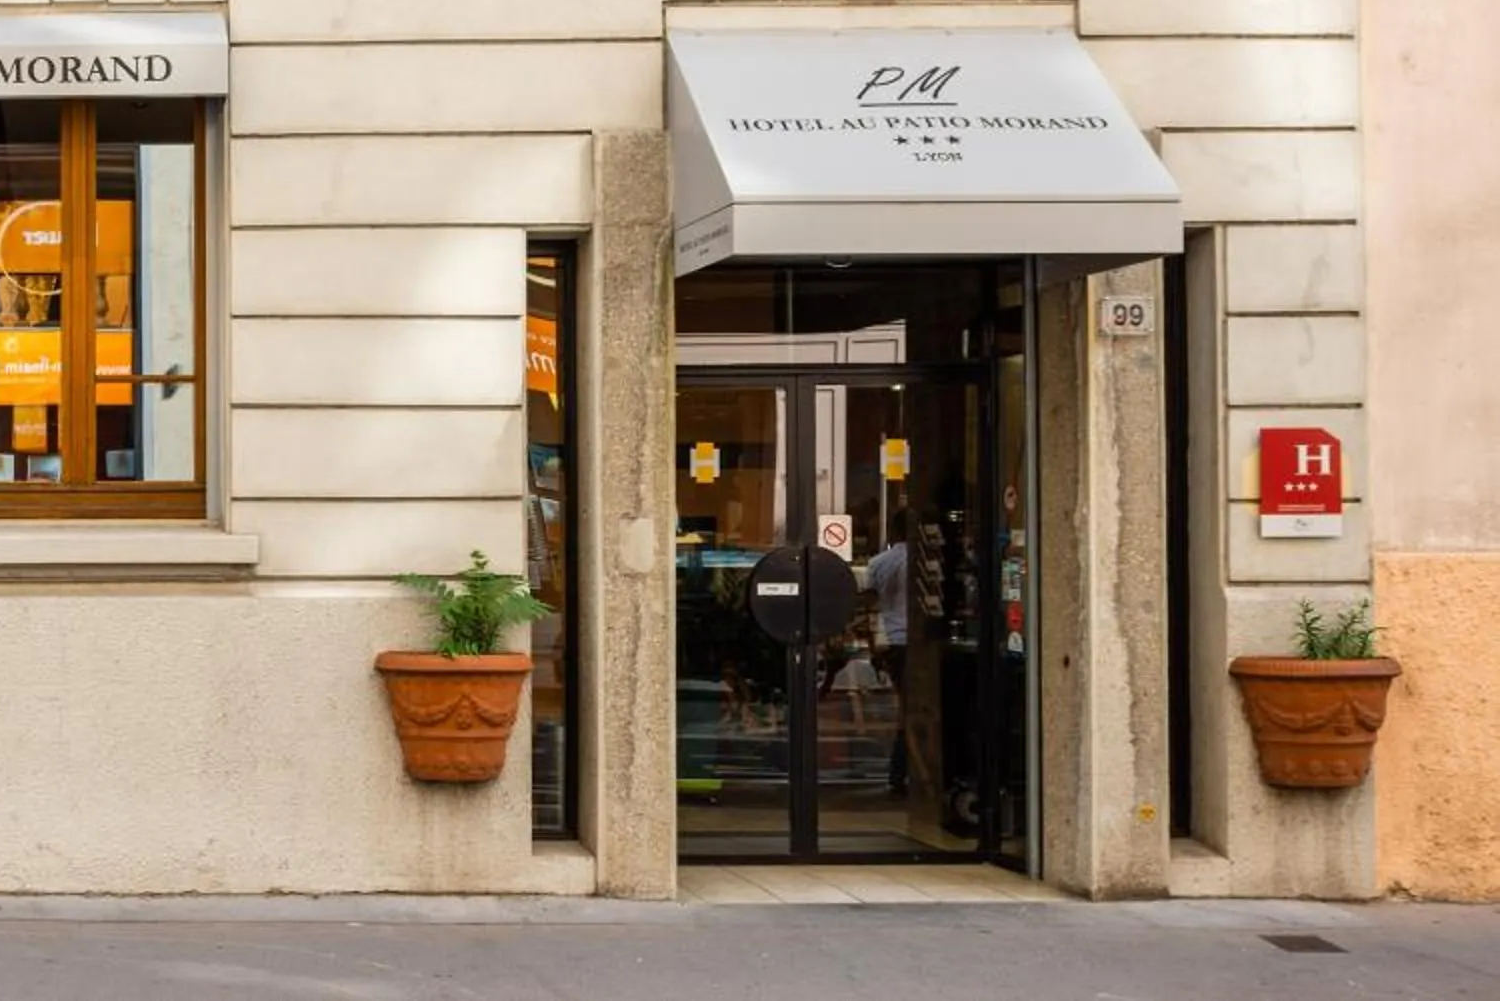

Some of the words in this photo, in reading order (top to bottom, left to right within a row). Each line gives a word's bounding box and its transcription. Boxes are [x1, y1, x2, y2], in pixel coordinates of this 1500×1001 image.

[728, 117, 834, 132] HOTEL
[840, 117, 877, 131] AU
[885, 115, 971, 130] PATIO
[978, 115, 1109, 131] MORAND
[911, 151, 964, 162] LYON
[1112, 303, 1146, 327] 99
[1293, 443, 1333, 477] H
